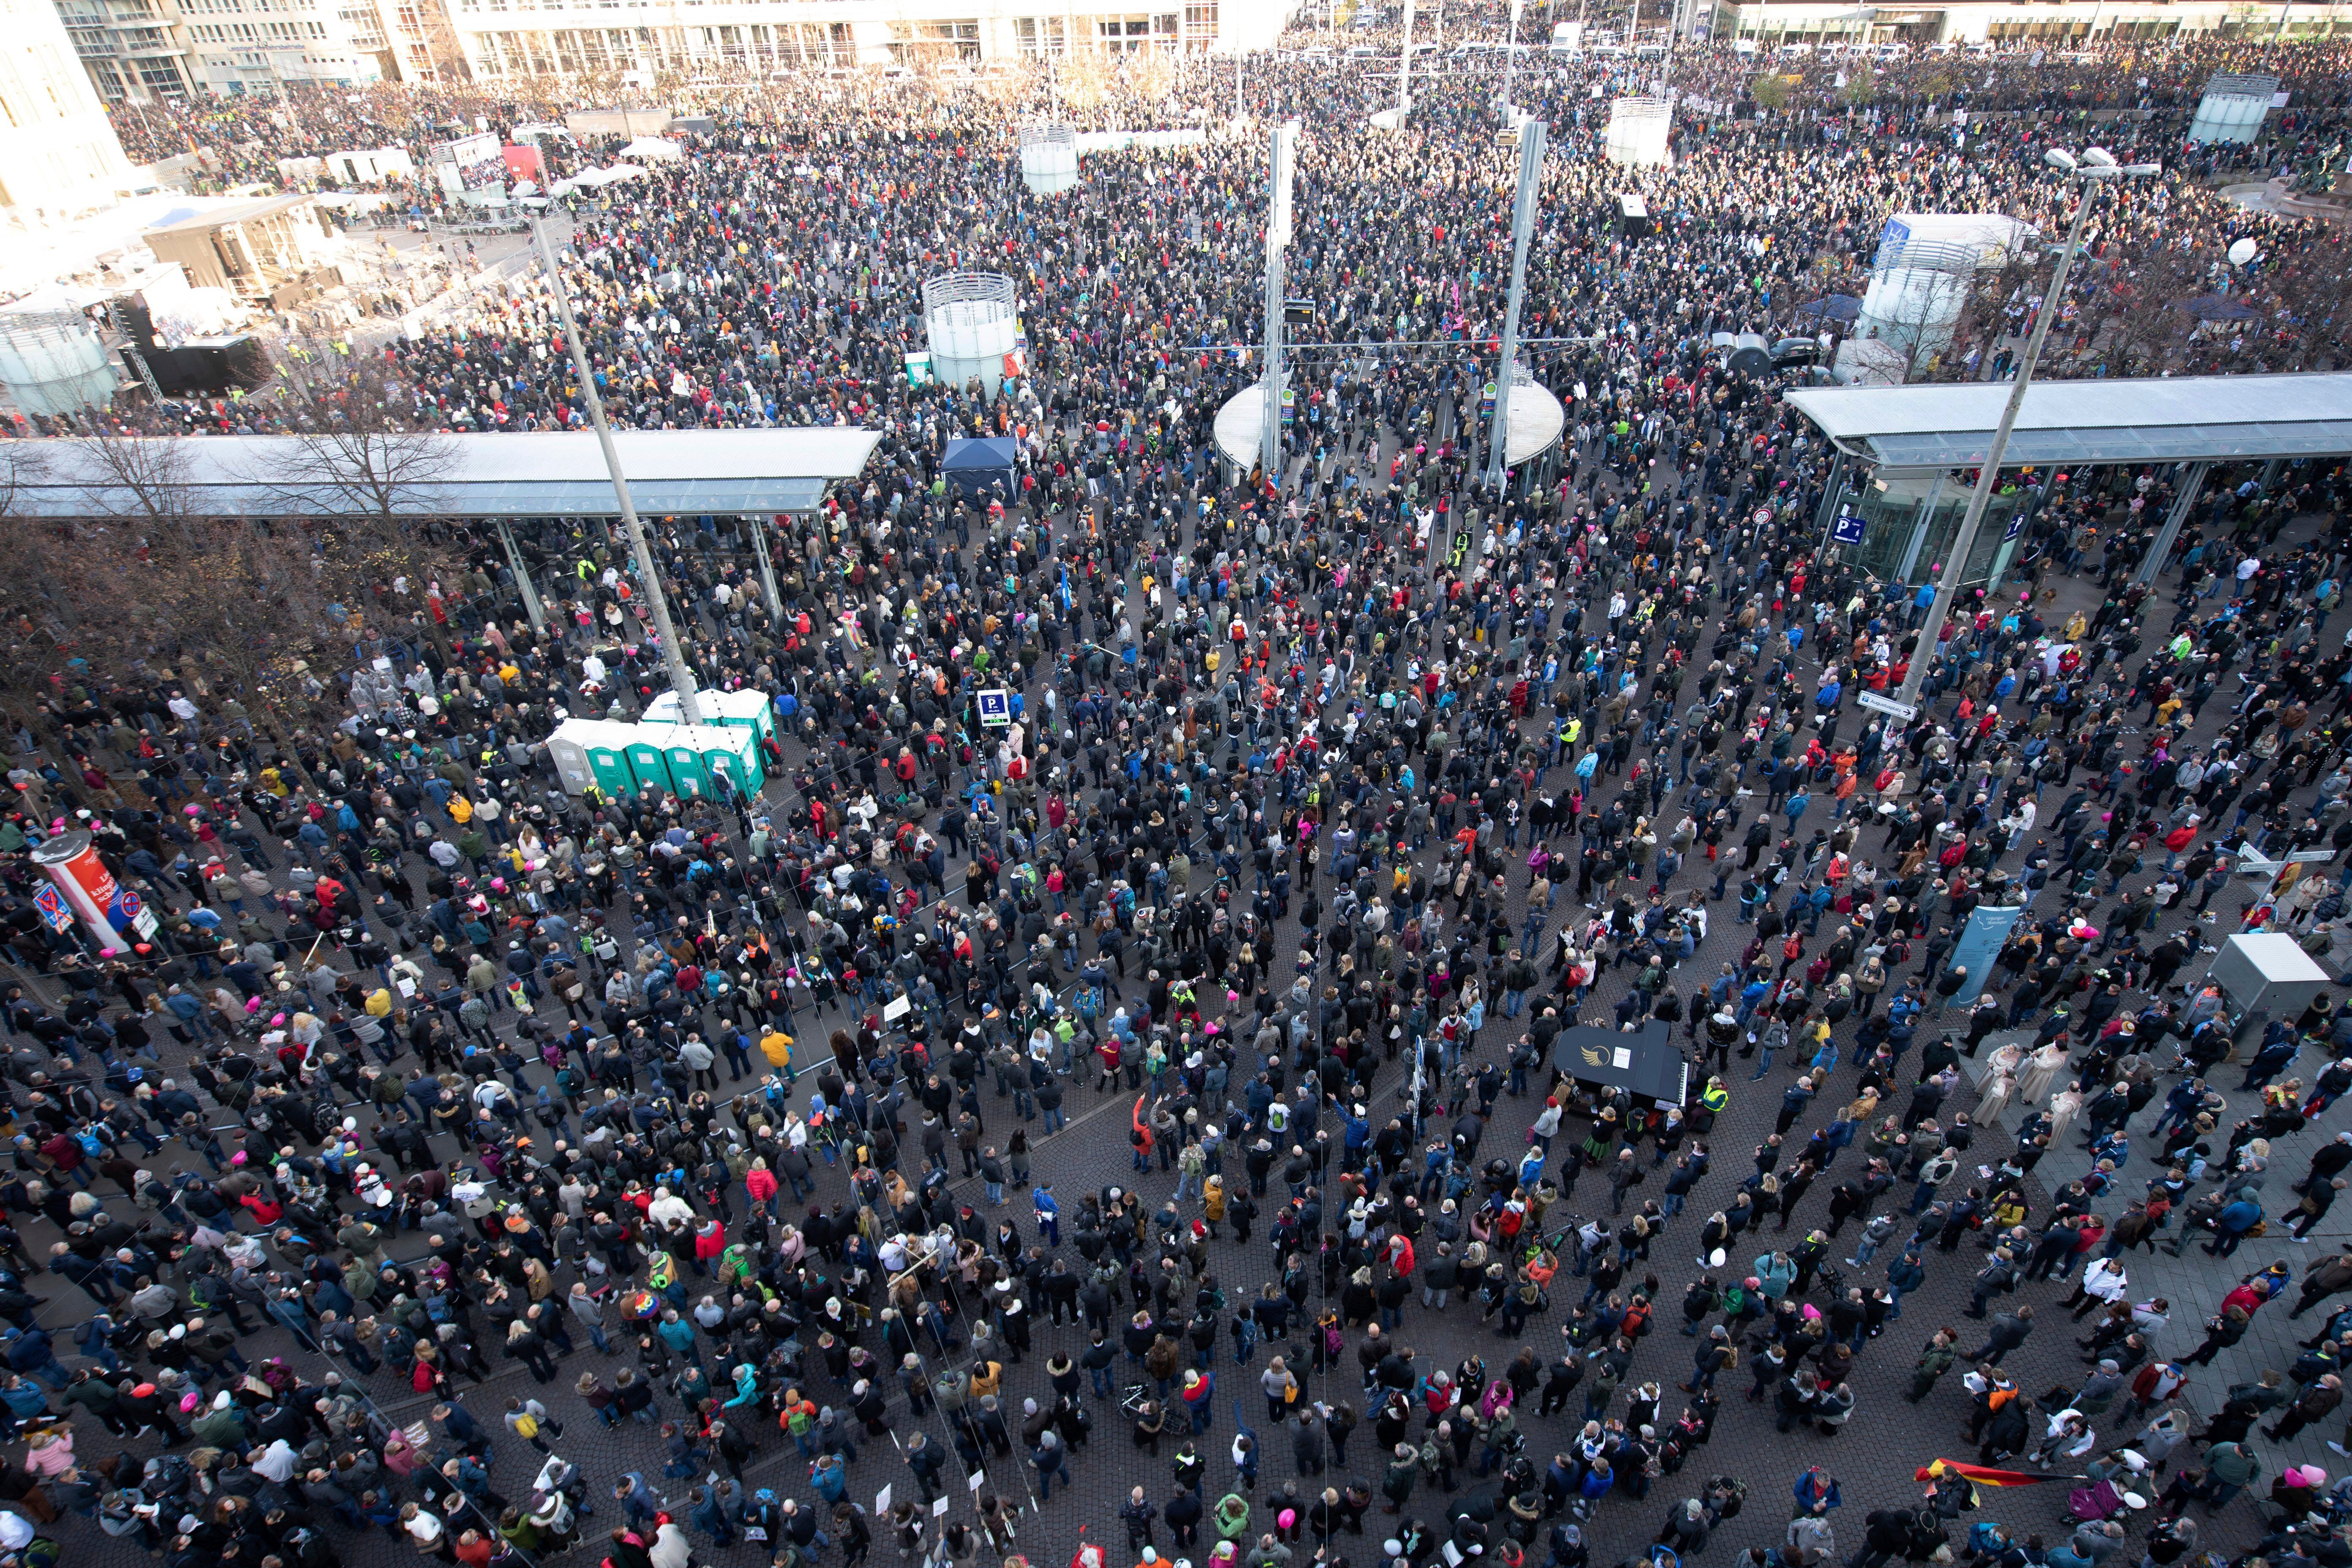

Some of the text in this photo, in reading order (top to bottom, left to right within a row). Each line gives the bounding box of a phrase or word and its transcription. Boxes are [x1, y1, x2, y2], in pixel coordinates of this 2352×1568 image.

[1836, 520, 1848, 532] P
[988, 698, 996, 709] P
[1870, 699, 1902, 713] Augustusplatz
[887, 1005, 908, 1019] FREIHEIT
